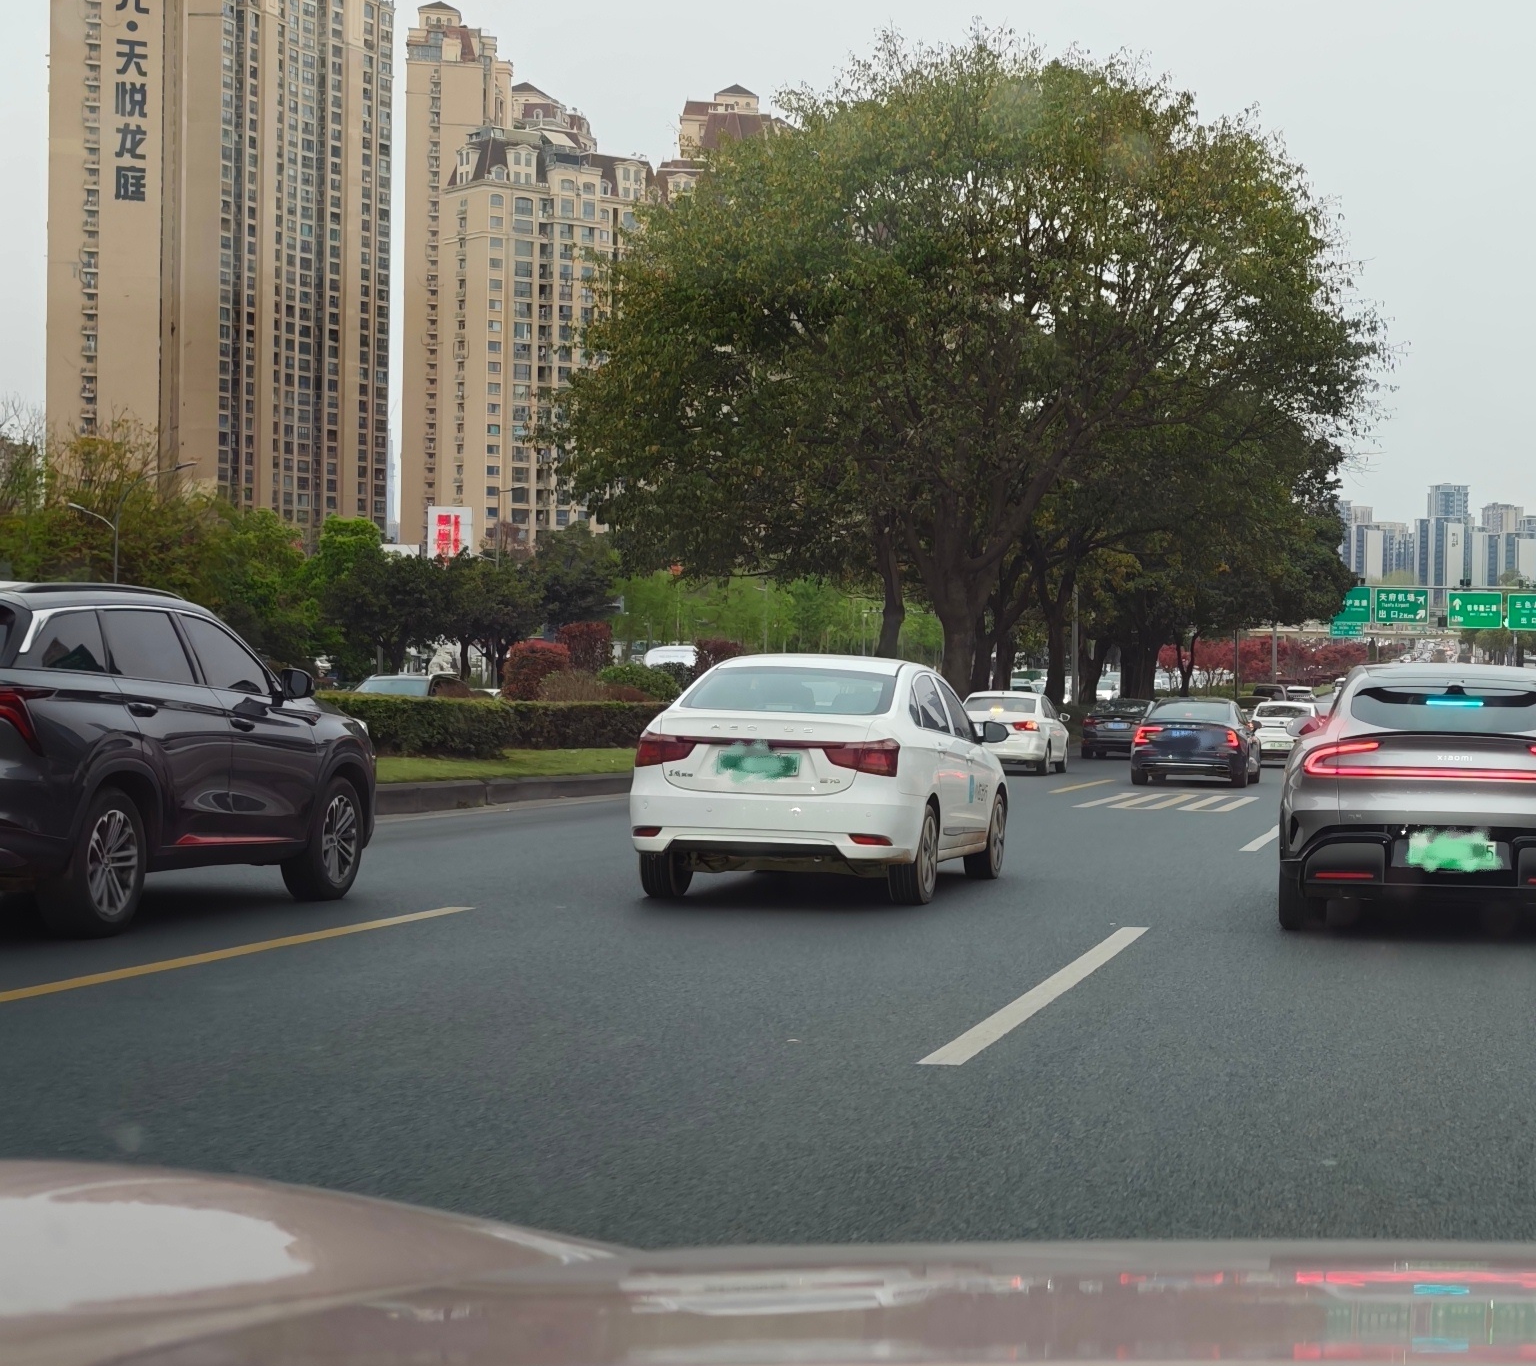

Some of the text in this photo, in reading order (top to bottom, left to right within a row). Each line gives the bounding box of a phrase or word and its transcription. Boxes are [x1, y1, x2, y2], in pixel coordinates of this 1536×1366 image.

[1379, 593, 1415, 602] 天府机场
[1378, 609, 1398, 618] 出口
